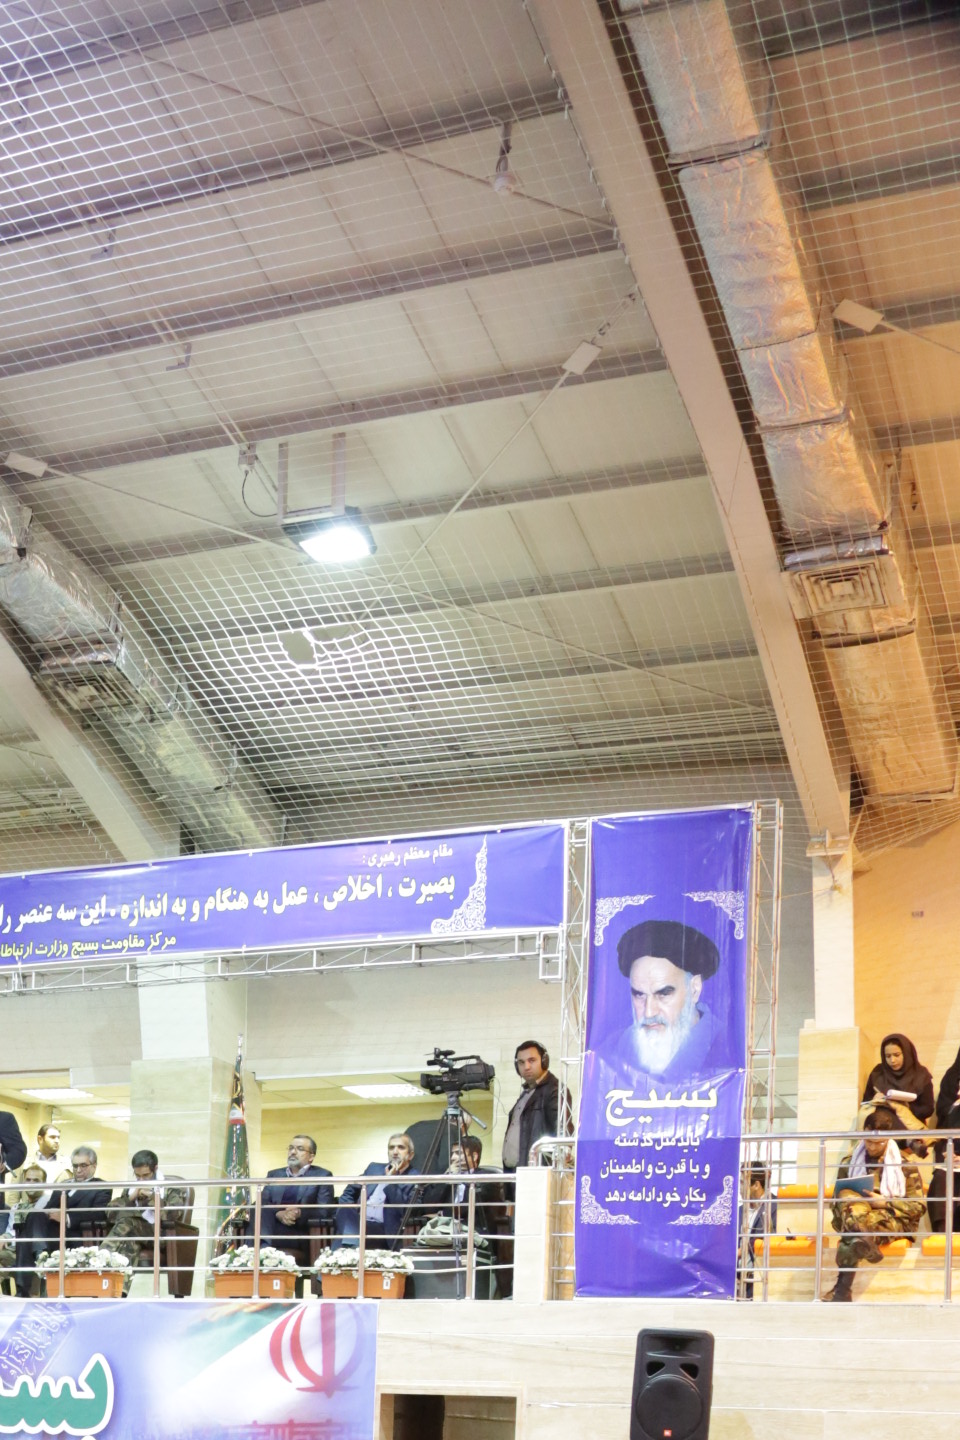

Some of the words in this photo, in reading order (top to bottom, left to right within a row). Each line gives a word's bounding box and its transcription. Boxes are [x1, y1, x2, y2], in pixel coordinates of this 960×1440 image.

[403, 846, 430, 866] معظم
[432, 843, 453, 864] مقام
[272, 881, 308, 914] عمل
[323, 873, 383, 911] اخلاص
[398, 874, 455, 904] بصیرت
[56, 903, 77, 921] سه
[80, 894, 107, 926] این
[120, 892, 168, 927] اندازه
[171, 896, 186, 922] به
[189, 900, 200, 922] و
[204, 887, 249, 921] هنگام
[253, 889, 269, 915] به
[14, 904, 53, 932] عنصر
[35, 939, 69, 958] وزارت
[70, 940, 98, 958] بسیج
[101, 933, 145, 953] مقاومت
[147, 931, 177, 951] مرکز
[605, 1086, 718, 1126] بسیج
[654, 1158, 686, 1179] قدرت
[689, 1158, 700, 1179] با
[701, 1163, 710, 1179] و
[605, 1189, 626, 1202] دهد
[628, 1186, 655, 1202] ادامه
[656, 1187, 680, 1207] خود
[681, 1187, 706, 1208] بکار
